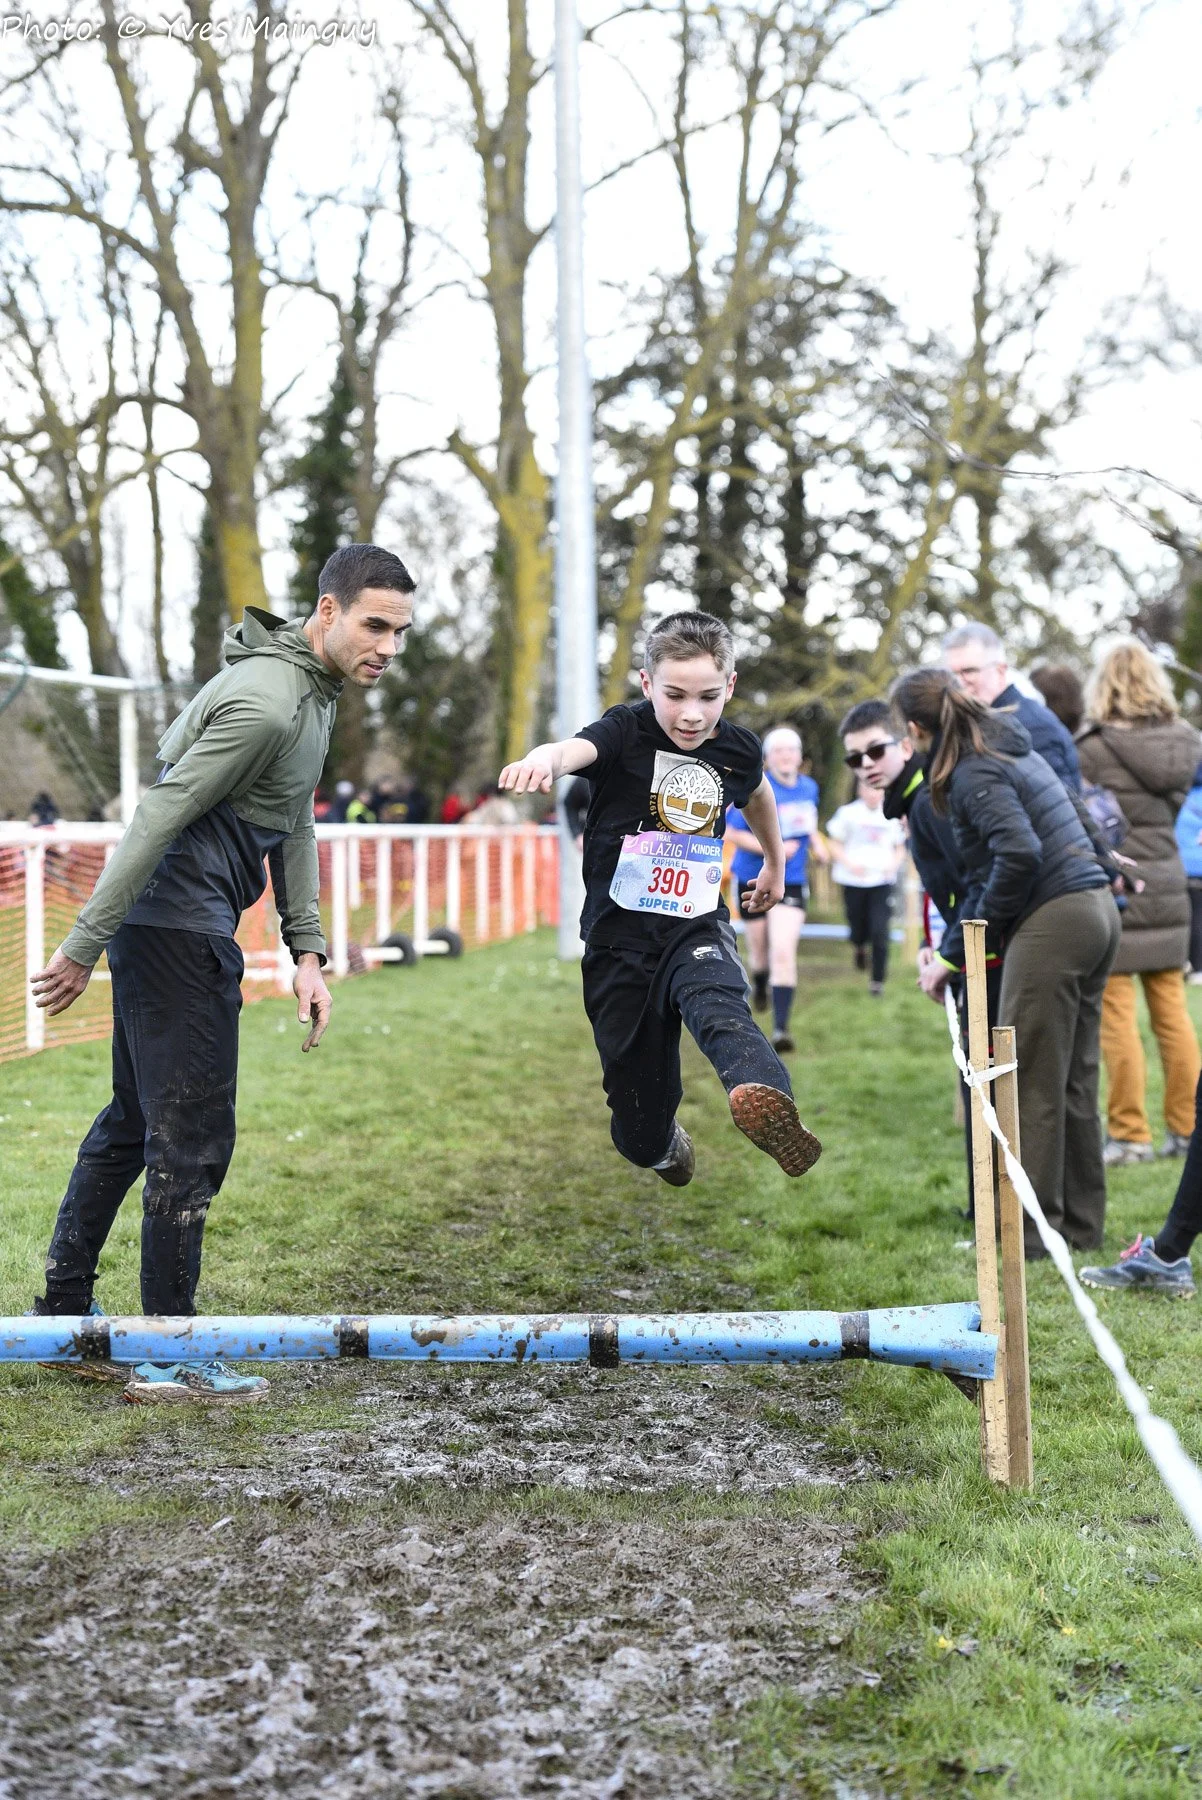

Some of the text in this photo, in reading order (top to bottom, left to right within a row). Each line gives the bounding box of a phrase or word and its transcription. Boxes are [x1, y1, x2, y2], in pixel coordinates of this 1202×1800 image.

[698, 759, 724, 806] TIMBERLAND
[649, 794, 658, 817] 1973
[655, 833, 672, 843] TRAIL
[640, 840, 684, 858] GLAZIG
[690, 843, 721, 857] KINDER
[647, 866, 690, 897] 390
[638, 897, 680, 912] SUPER
